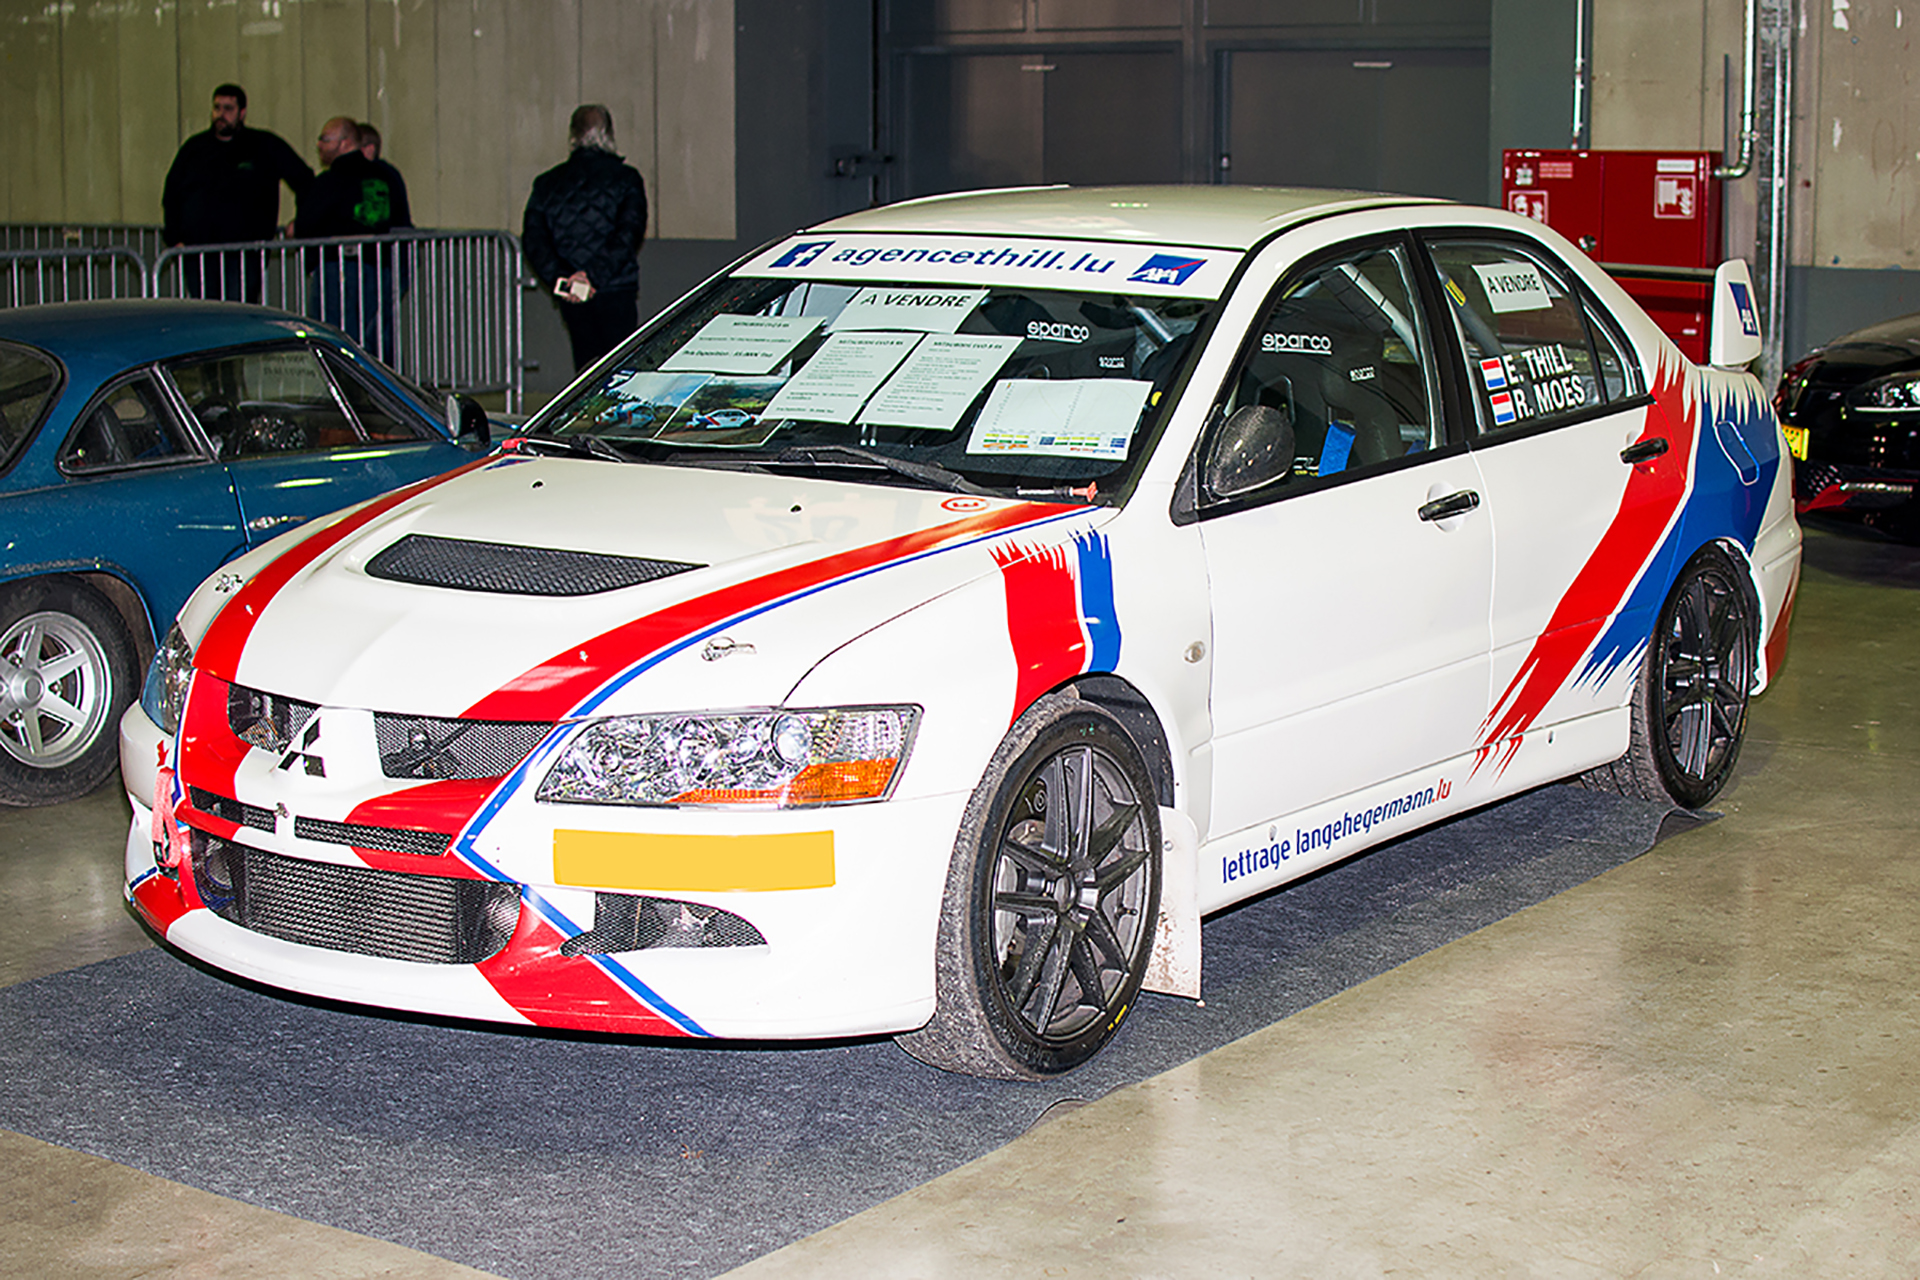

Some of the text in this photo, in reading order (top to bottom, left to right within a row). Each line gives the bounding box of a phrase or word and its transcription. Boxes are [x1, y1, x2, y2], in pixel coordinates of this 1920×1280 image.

[831, 247, 1116, 273] agencethill.lu
[1486, 273, 1540, 294] A VENDRE
[860, 293, 972, 308] A VENDRE
[1027, 320, 1090, 344] sparco
[1261, 332, 1332, 355] sparco
[1502, 343, 1574, 386] E. THILL
[1512, 374, 1586, 420] R. MOES
[1222, 778, 1452, 884] lettrage langehegermann.lu
